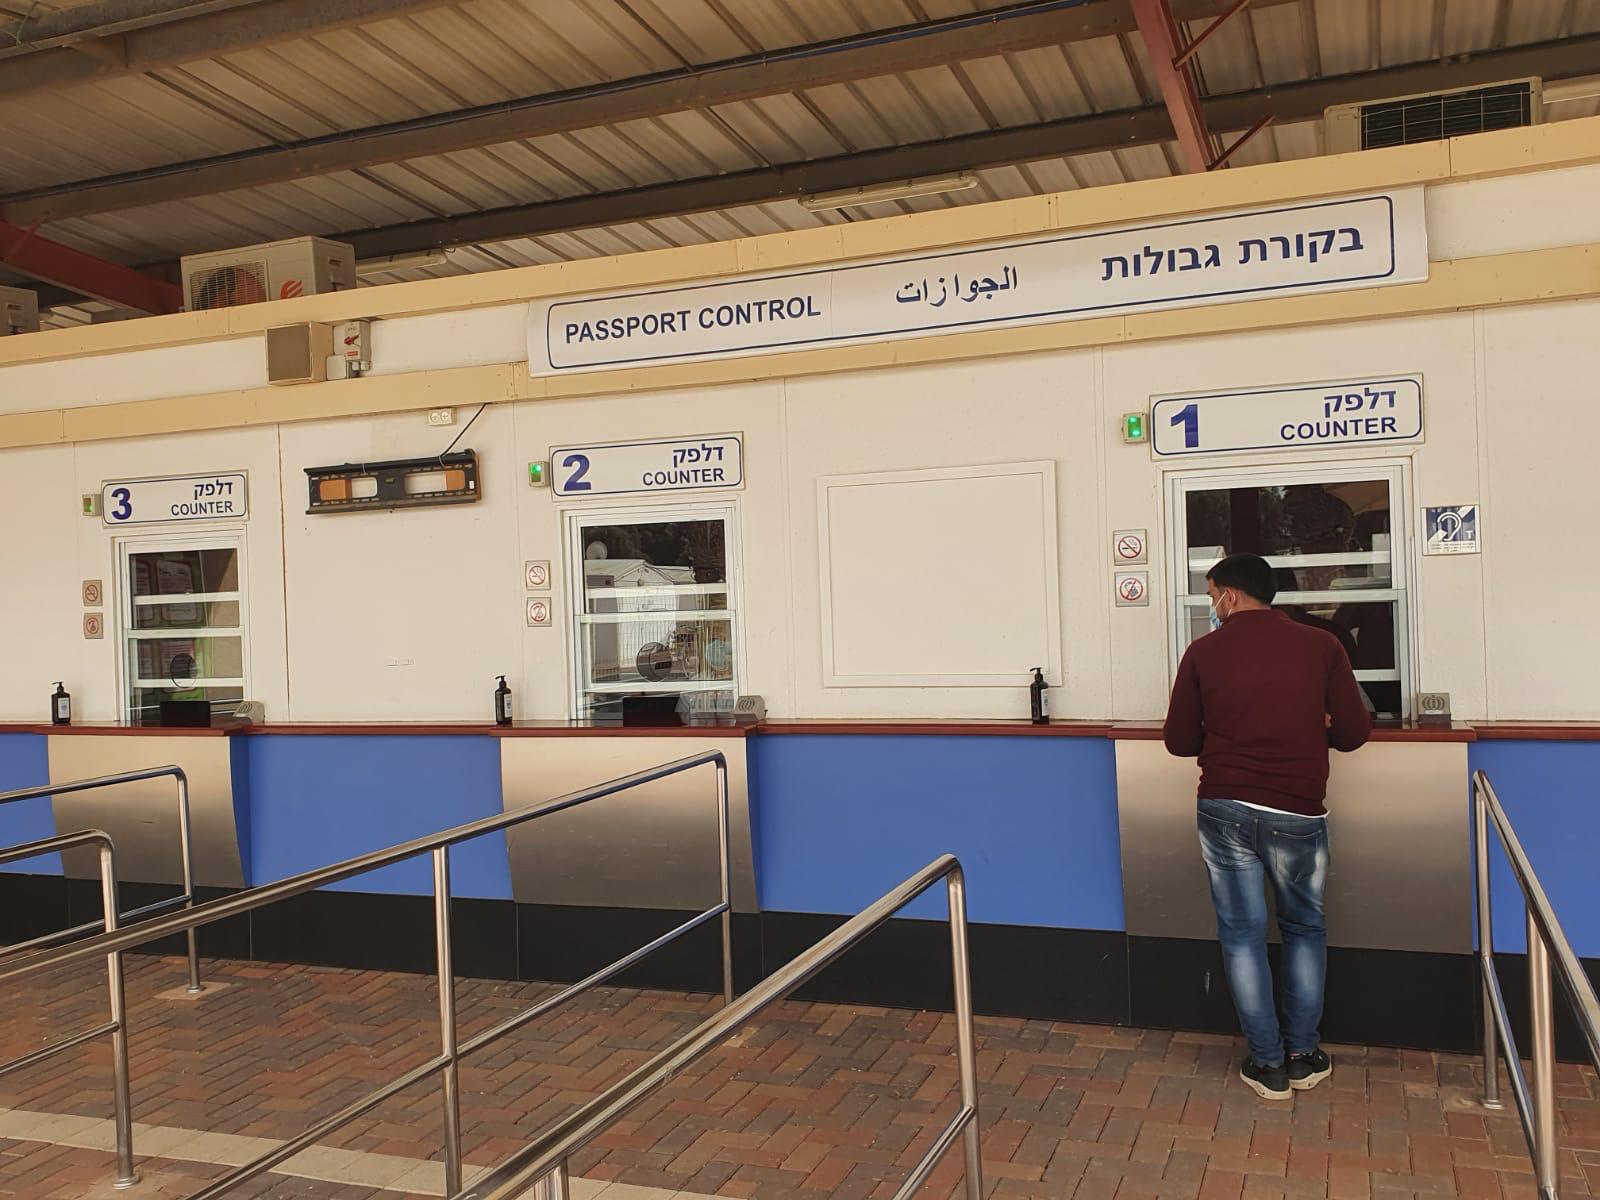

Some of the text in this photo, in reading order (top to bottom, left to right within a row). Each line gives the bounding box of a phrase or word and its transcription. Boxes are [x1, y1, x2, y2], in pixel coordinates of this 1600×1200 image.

[1101, 227, 1364, 281] בקורת גבולות
[895, 264, 1019, 308] الجوازات
[565, 295, 821, 344] PASSPORT CONTROL
[1323, 387, 1397, 418] דלפק
[1170, 403, 1199, 449] 1
[1280, 416, 1398, 441] COUNTER
[672, 443, 724, 468] דלפק
[562, 454, 592, 492] 2
[642, 468, 725, 486] COUNTER
[111, 487, 133, 520] 3
[194, 479, 233, 500] דלפק
[171, 500, 234, 516] COUNTER
[1465, 530, 1473, 540] T
